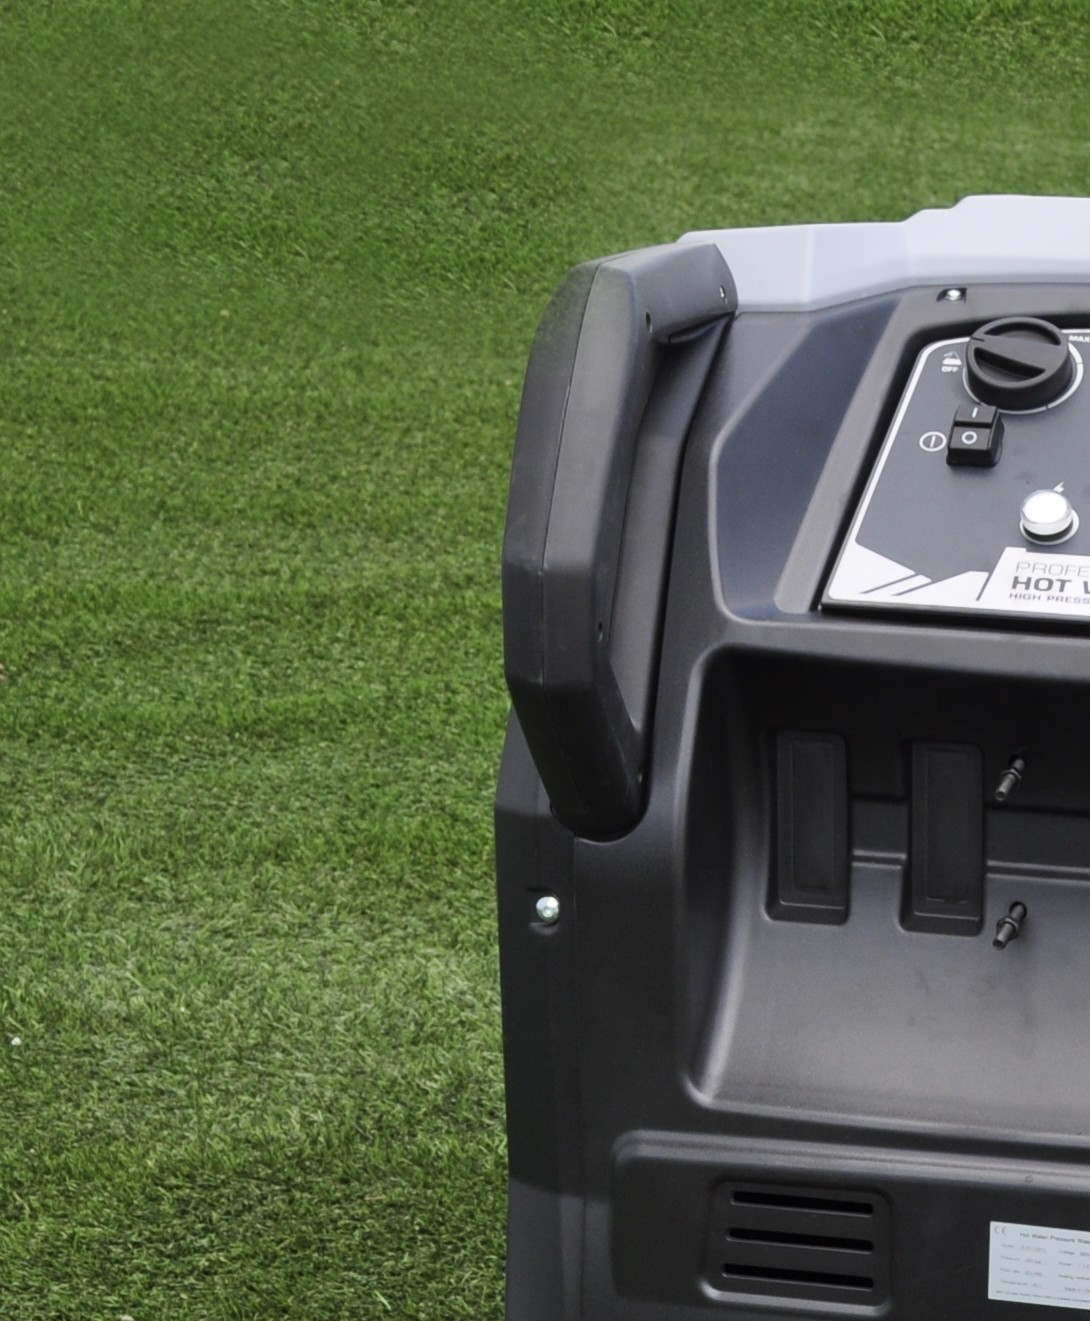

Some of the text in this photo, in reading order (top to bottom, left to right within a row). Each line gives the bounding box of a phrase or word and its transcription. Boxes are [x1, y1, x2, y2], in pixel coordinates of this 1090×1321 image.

[1068, 335, 1090, 343] MAX
[1011, 576, 1071, 593] HOT
[1009, 592, 1042, 601] HIGH
